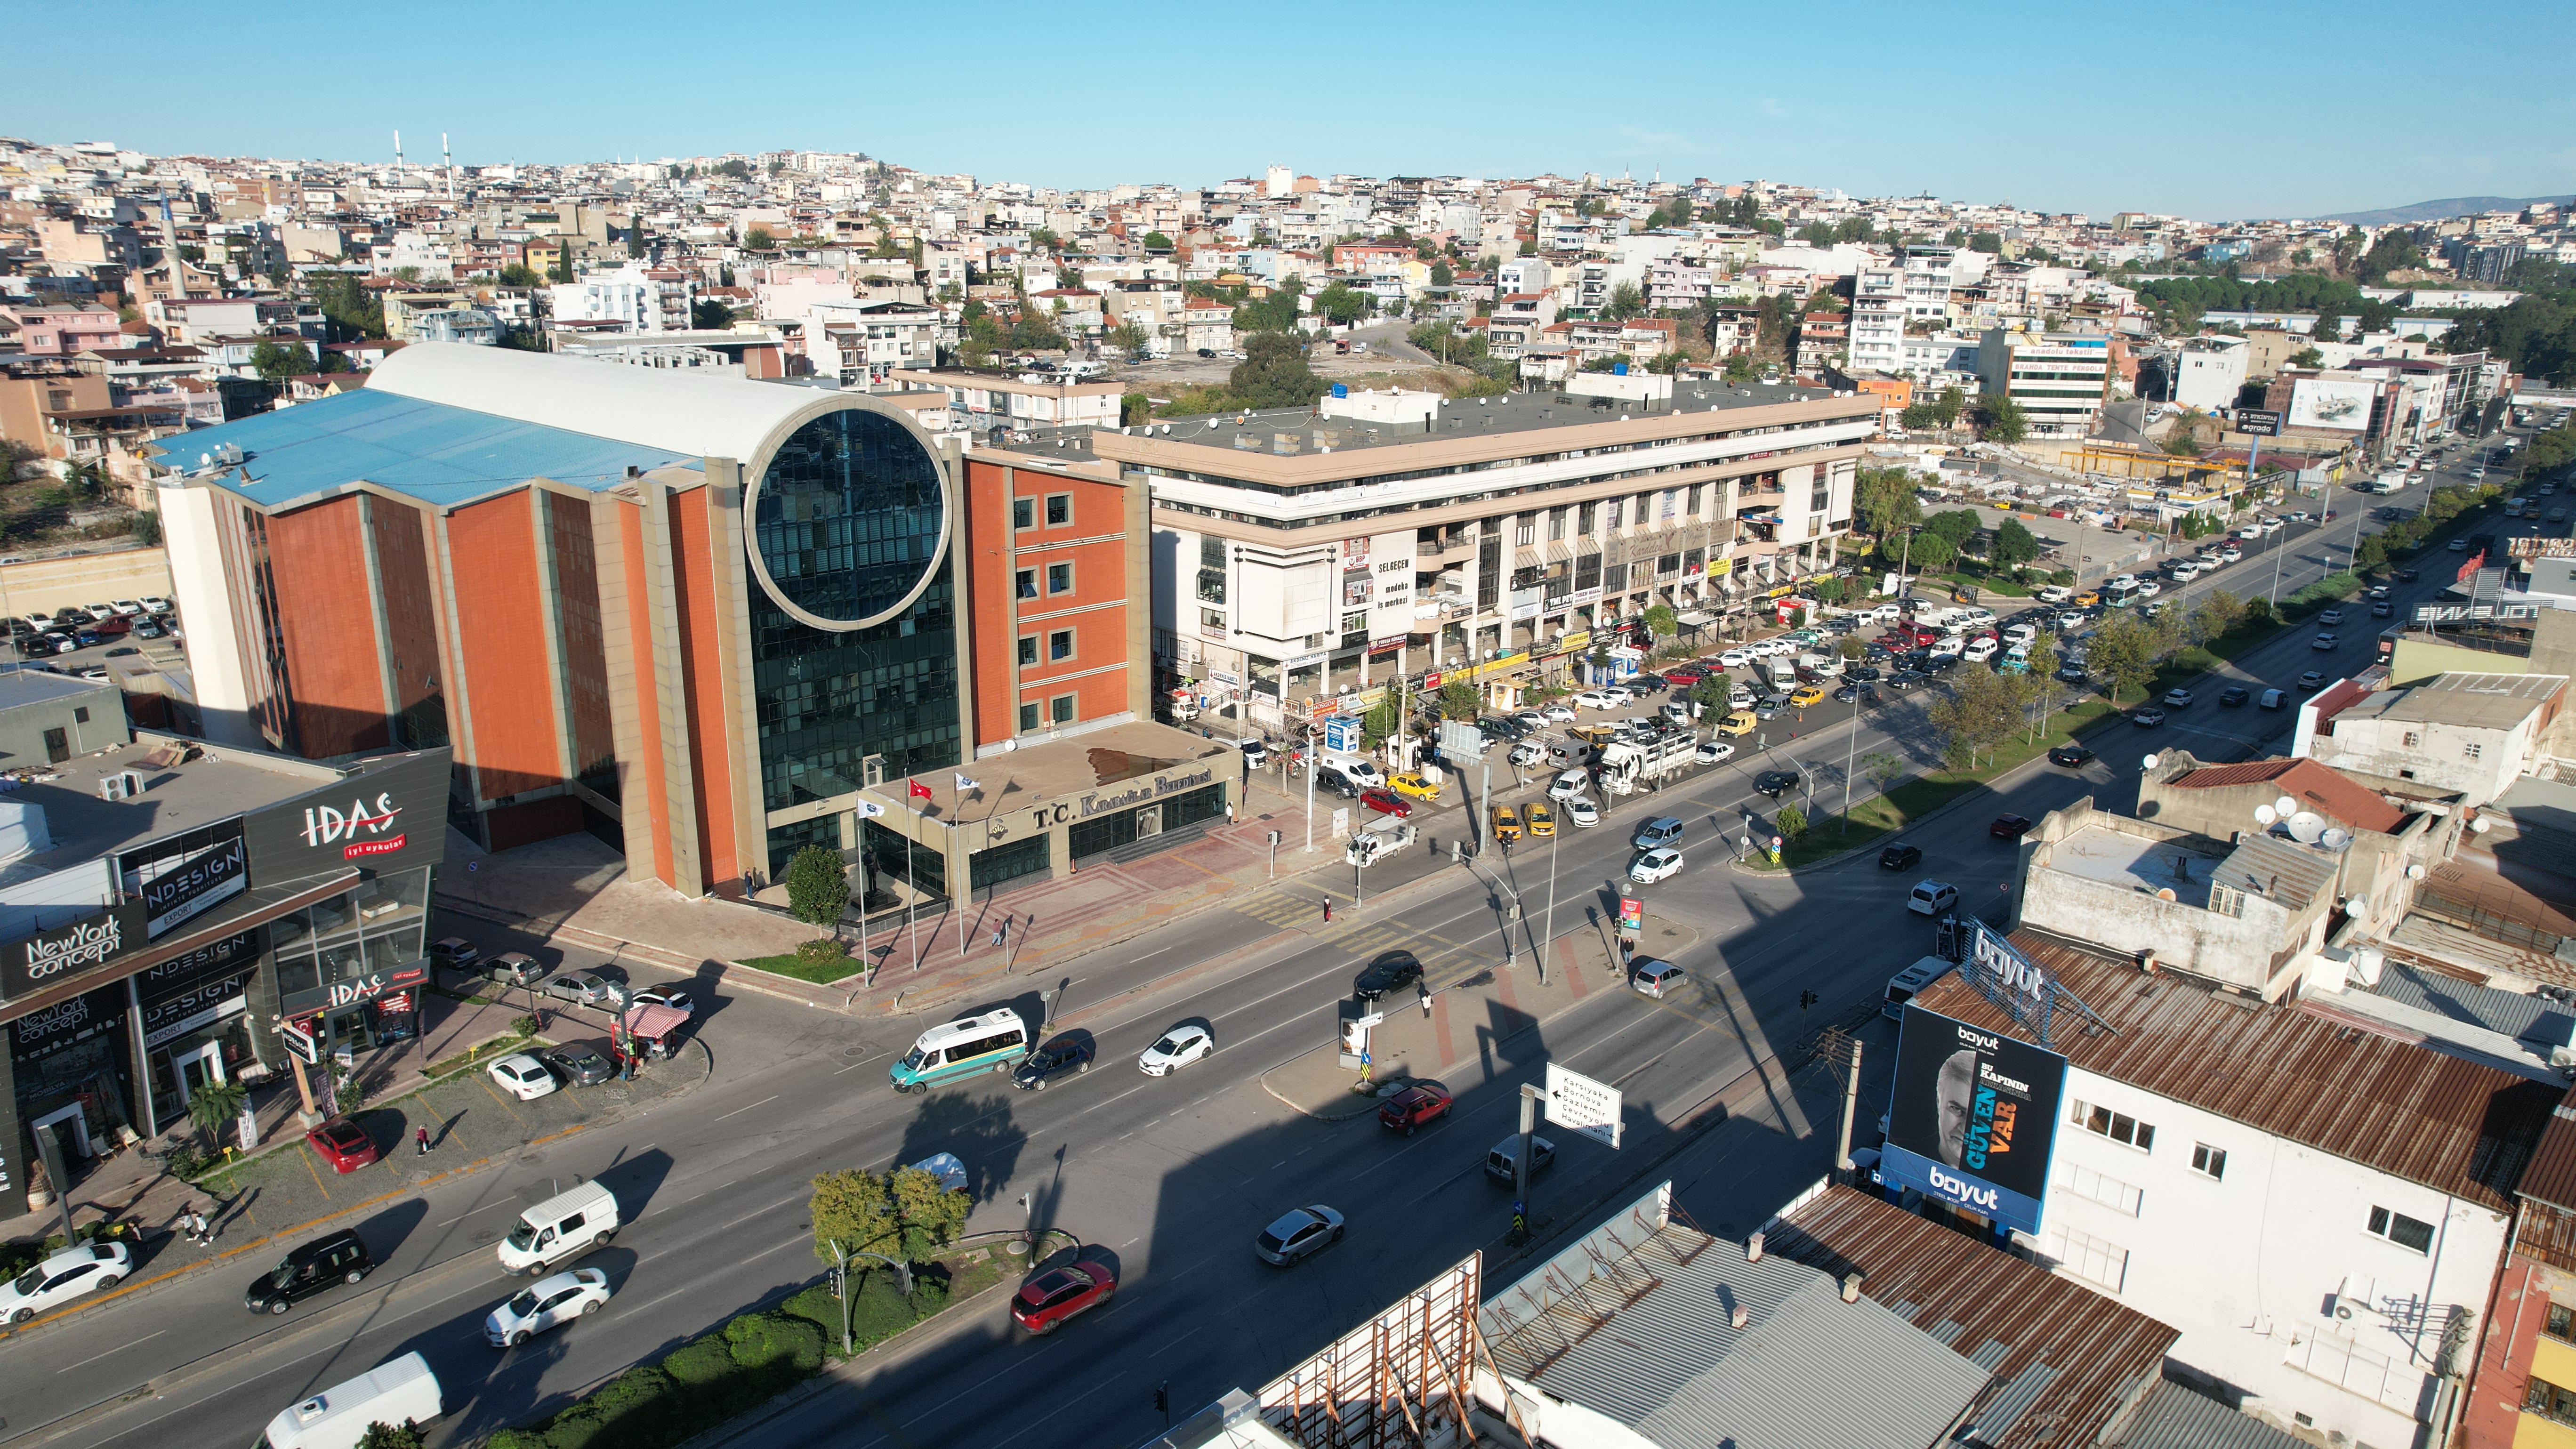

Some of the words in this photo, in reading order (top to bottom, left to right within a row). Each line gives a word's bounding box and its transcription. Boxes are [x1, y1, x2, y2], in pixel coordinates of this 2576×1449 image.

[2326, 383, 2367, 391] MARWOOD
[1629, 541, 1663, 558] Kardelen
[1378, 559, 1409, 573] SELGEÇEN
[1385, 582, 1408, 593] modeka
[1378, 601, 1383, 610] iş
[1385, 596, 1408, 608] merkezi
[1550, 597, 1562, 606] TML
[1562, 594, 1573, 604] PET
[1032, 802, 1077, 830] T.C.
[348, 845, 362, 856] iyi
[365, 839, 402, 852] uykular
[148, 846, 241, 908] NDESIGN
[164, 903, 193, 925] EXPORT
[28, 934, 121, 979] concept
[150, 935, 245, 980] NDESIGN
[1979, 973, 1991, 987] STEEL
[1991, 982, 2003, 996] DOOR
[147, 976, 240, 1022] DESIGN
[19, 1007, 89, 1044] concept
[147, 1023, 182, 1043] EXPORT
[1981, 1062, 1994, 1072] BU
[1564, 1077, 1608, 1101] Karşıyaka
[1979, 1078, 2032, 1102] ARKASINDA
[1980, 1069, 2030, 1093] KAPININ
[1563, 1095, 1606, 1117] Gaziemir
[1564, 1086, 1601, 1107] Bornova
[1562, 1104, 1610, 1128] Çevreyolu
[1562, 1113, 1606, 1136] Havalimanı
[1966, 1084, 1997, 1169] GÜVEN
[1989, 1100, 2017, 1154] VAR
[1933, 1191, 1946, 1199] STEEL
[1964, 1203, 1978, 1212] ÇELİK
[1978, 1208, 1989, 1216] KAPI
